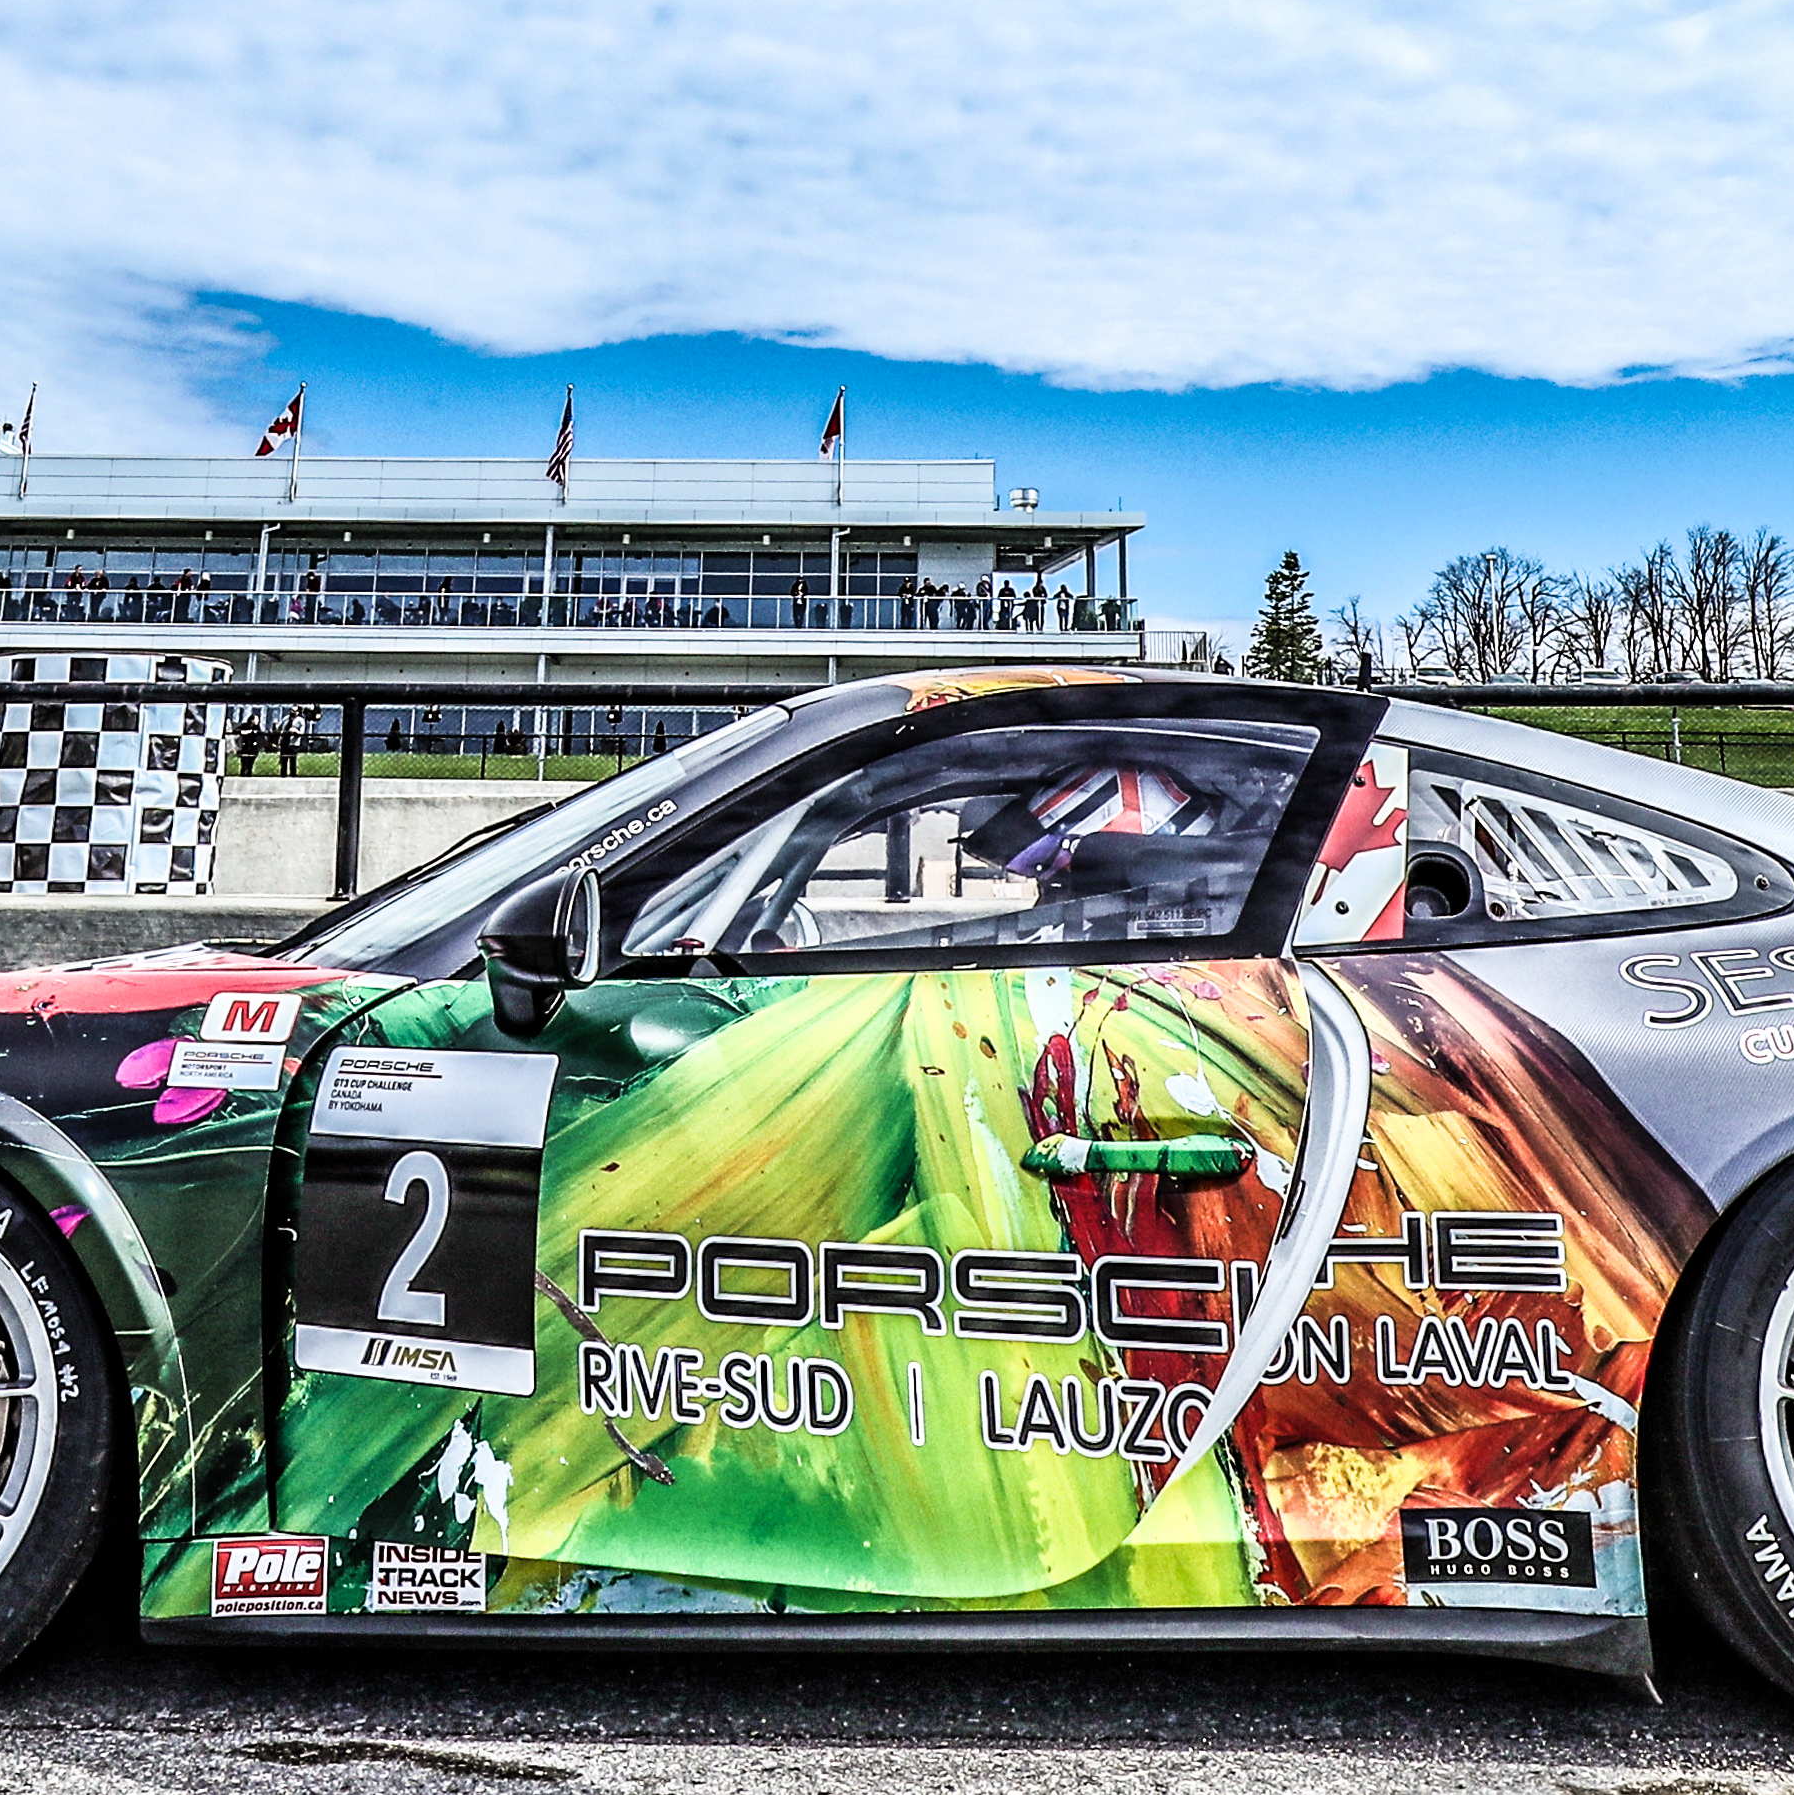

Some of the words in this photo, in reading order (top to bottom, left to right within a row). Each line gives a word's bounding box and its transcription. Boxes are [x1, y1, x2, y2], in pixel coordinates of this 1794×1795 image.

[555, 799, 678, 874] orsche.ca
[221, 1000, 281, 1033] M
[183, 1051, 265, 1061] PORSCHE
[340, 1058, 435, 1073] PORSCHE
[179, 1070, 204, 1078] NORTH
[204, 1071, 234, 1079] AMERICA
[181, 1063, 228, 1071] MOTORSPORT
[330, 1089, 363, 1100] CANADA
[333, 1078, 350, 1089] GT3
[350, 1079, 367, 1090] CUP
[367, 1080, 414, 1092] CHALLENGE
[328, 1100, 340, 1110] BY
[340, 1101, 384, 1113] YOKOHAMA
[376, 1150, 451, 1328] 2
[19, 1259, 50, 1296] LF
[578, 1211, 1568, 1354] PORSCHE
[391, 1345, 458, 1372] IMSA
[1375, 1314, 1577, 1392] LAVAL
[578, 1340, 854, 1437] RIVE-SUD
[1423, 1517, 1570, 1564] BOSS
[378, 1544, 482, 1564] INSIDE
[378, 1567, 482, 1589] TRACK
[1429, 1563, 1492, 1576] HUGO
[1507, 1565, 1571, 1579] BOSS
[220, 1584, 316, 1594] MAGAZINE
[215, 1599, 325, 1615] poleposition.ca
